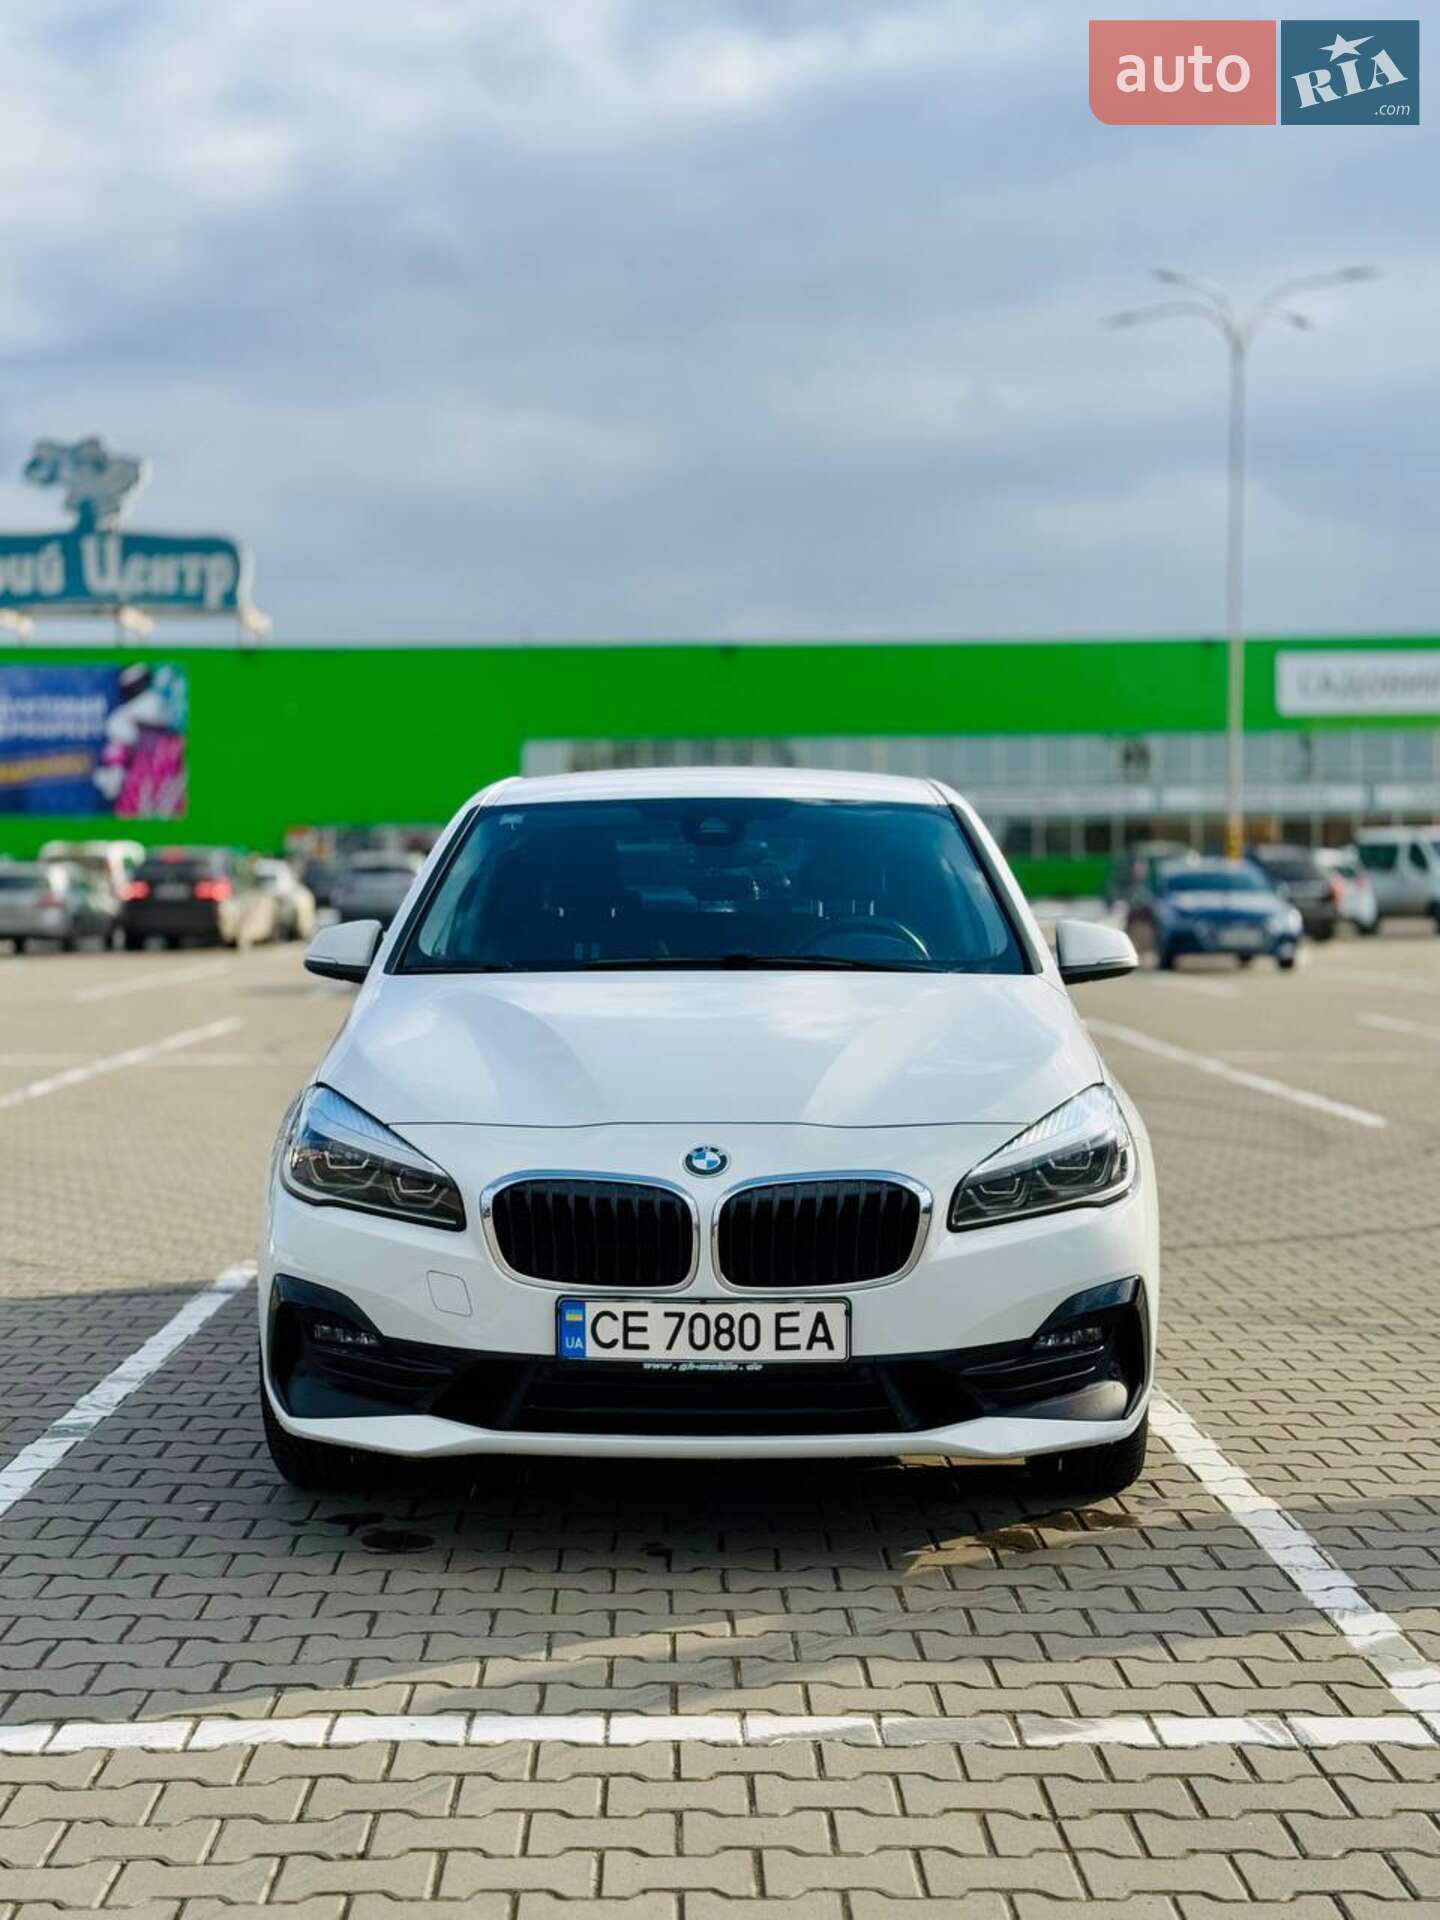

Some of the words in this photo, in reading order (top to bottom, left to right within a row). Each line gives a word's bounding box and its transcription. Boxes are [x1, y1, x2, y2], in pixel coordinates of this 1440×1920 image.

[80, 532, 235, 610] Центр
[565, 1336, 583, 1349] UA
[590, 1310, 650, 1351] CE
[663, 1312, 762, 1351] 7080
[774, 1311, 835, 1351] EA
